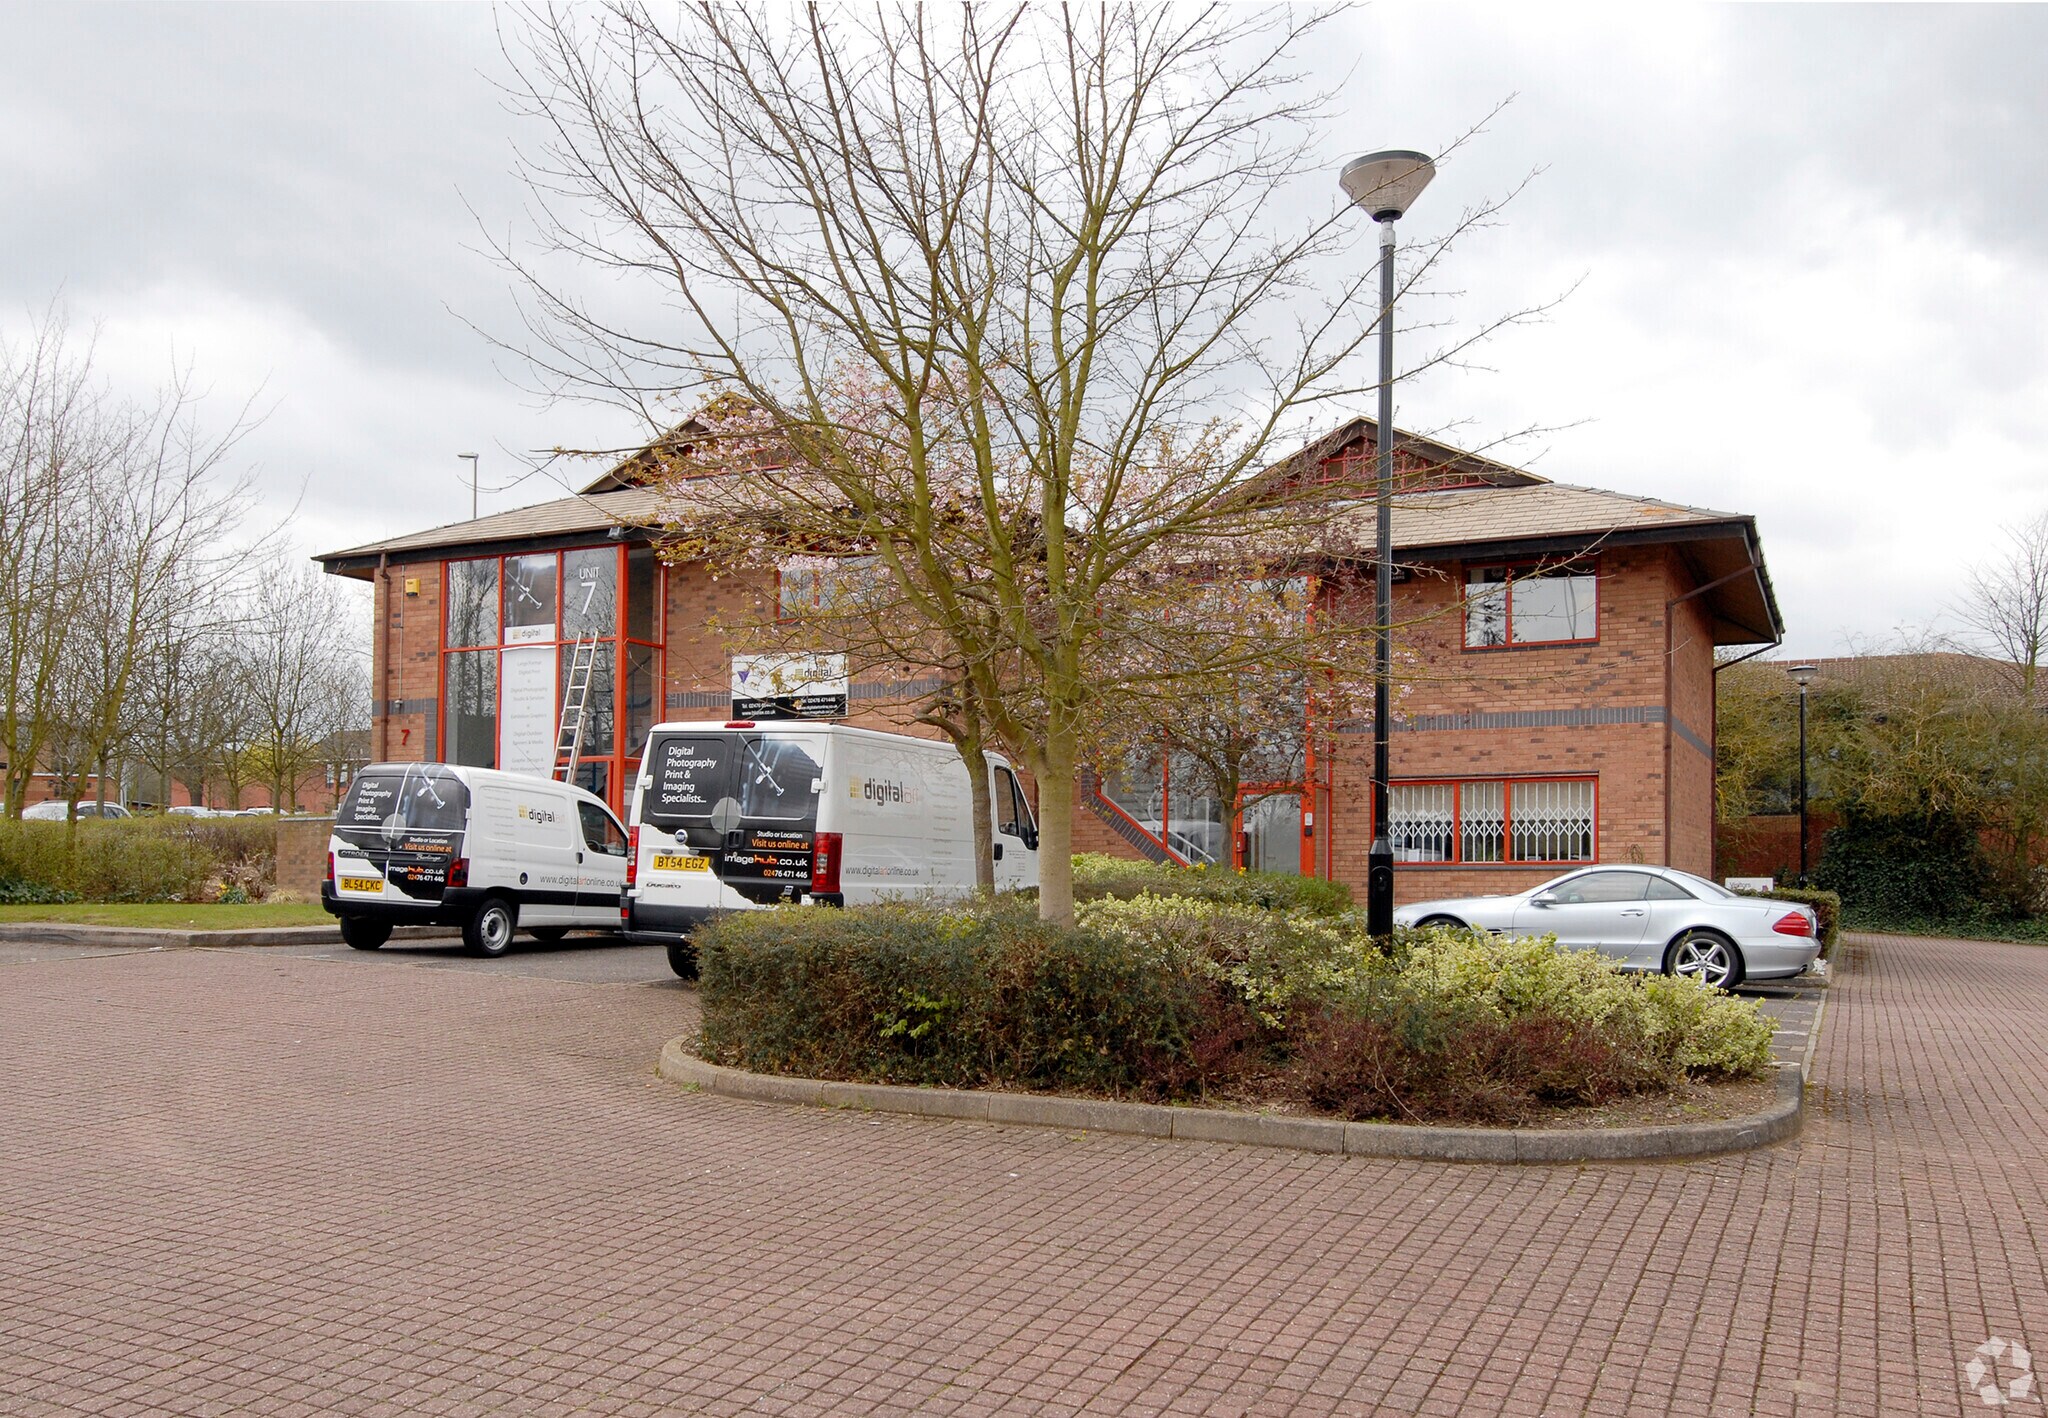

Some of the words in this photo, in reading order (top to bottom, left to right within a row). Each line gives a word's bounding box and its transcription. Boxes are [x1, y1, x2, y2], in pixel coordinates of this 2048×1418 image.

[579, 566, 600, 579] UNIT
[581, 581, 596, 615] 7
[401, 729, 411, 746] 7
[668, 746, 694, 757] Digital
[666, 758, 717, 769] Photography
[664, 769, 683, 779] Print
[683, 770, 691, 779] &
[361, 781, 380, 790] Digital
[663, 781, 695, 793] Imaging
[359, 789, 392, 798] Photography
[355, 805, 377, 814] Imaging
[756, 830, 773, 838] Studio
[780, 831, 803, 839] Location
[404, 842, 417, 851] Visit
[426, 844, 444, 852] online
[751, 838, 767, 848] Visit
[777, 839, 801, 849] online
[802, 841, 808, 849] at
[657, 857, 682, 868] BT54
[685, 857, 706, 869] EGZ
[724, 852, 808, 867] imagehub.co.uk
[407, 873, 424, 881] 02476
[763, 870, 782, 878] 02476
[782, 870, 795, 878] 471
[795, 870, 808, 879] 446
[343, 878, 363, 890] BL54
[365, 880, 381, 891] CKC
